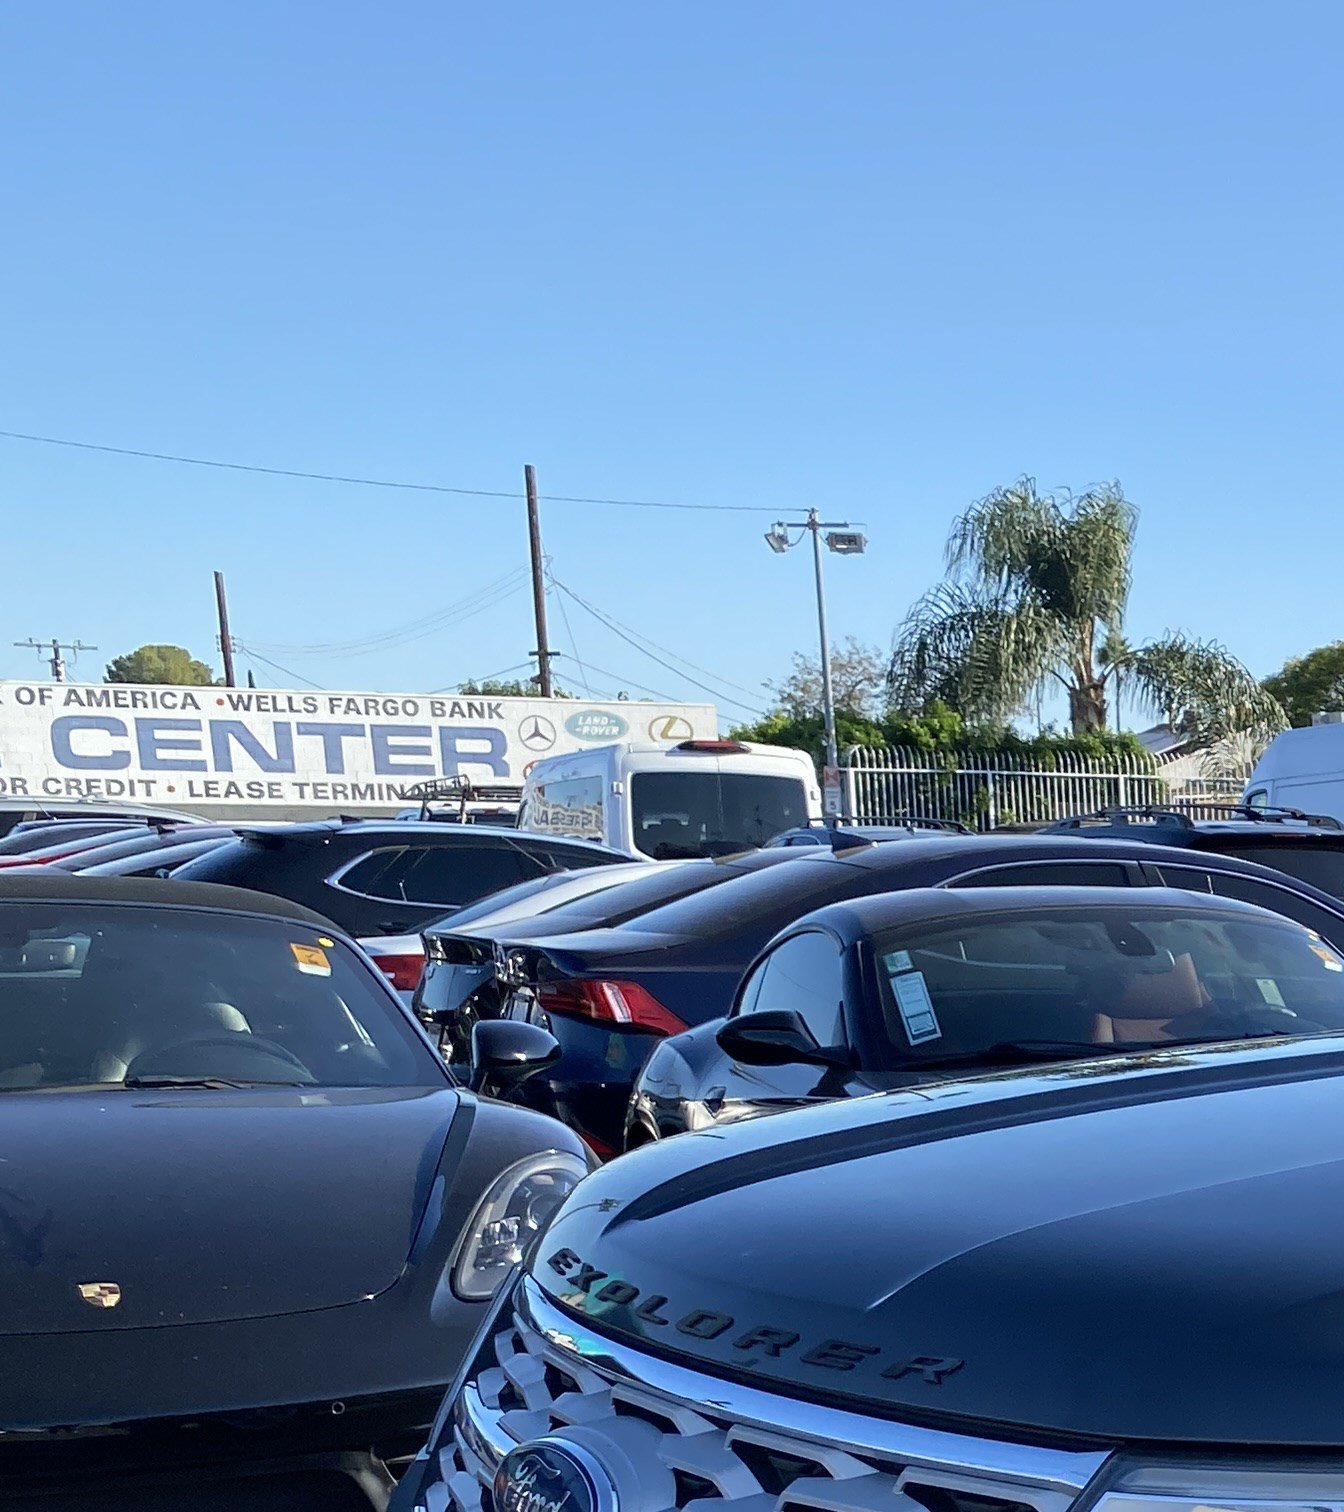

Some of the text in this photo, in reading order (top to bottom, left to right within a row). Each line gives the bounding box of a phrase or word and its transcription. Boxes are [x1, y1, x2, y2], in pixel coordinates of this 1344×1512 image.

[15, 687, 505, 720] OF AMERICA WELLS FARGO BANK
[50, 714, 511, 778] CENTER
[42, 777, 157, 797] CREDIT
[188, 779, 284, 800] LEASE
[547, 1247, 967, 1386] EXPLORER
